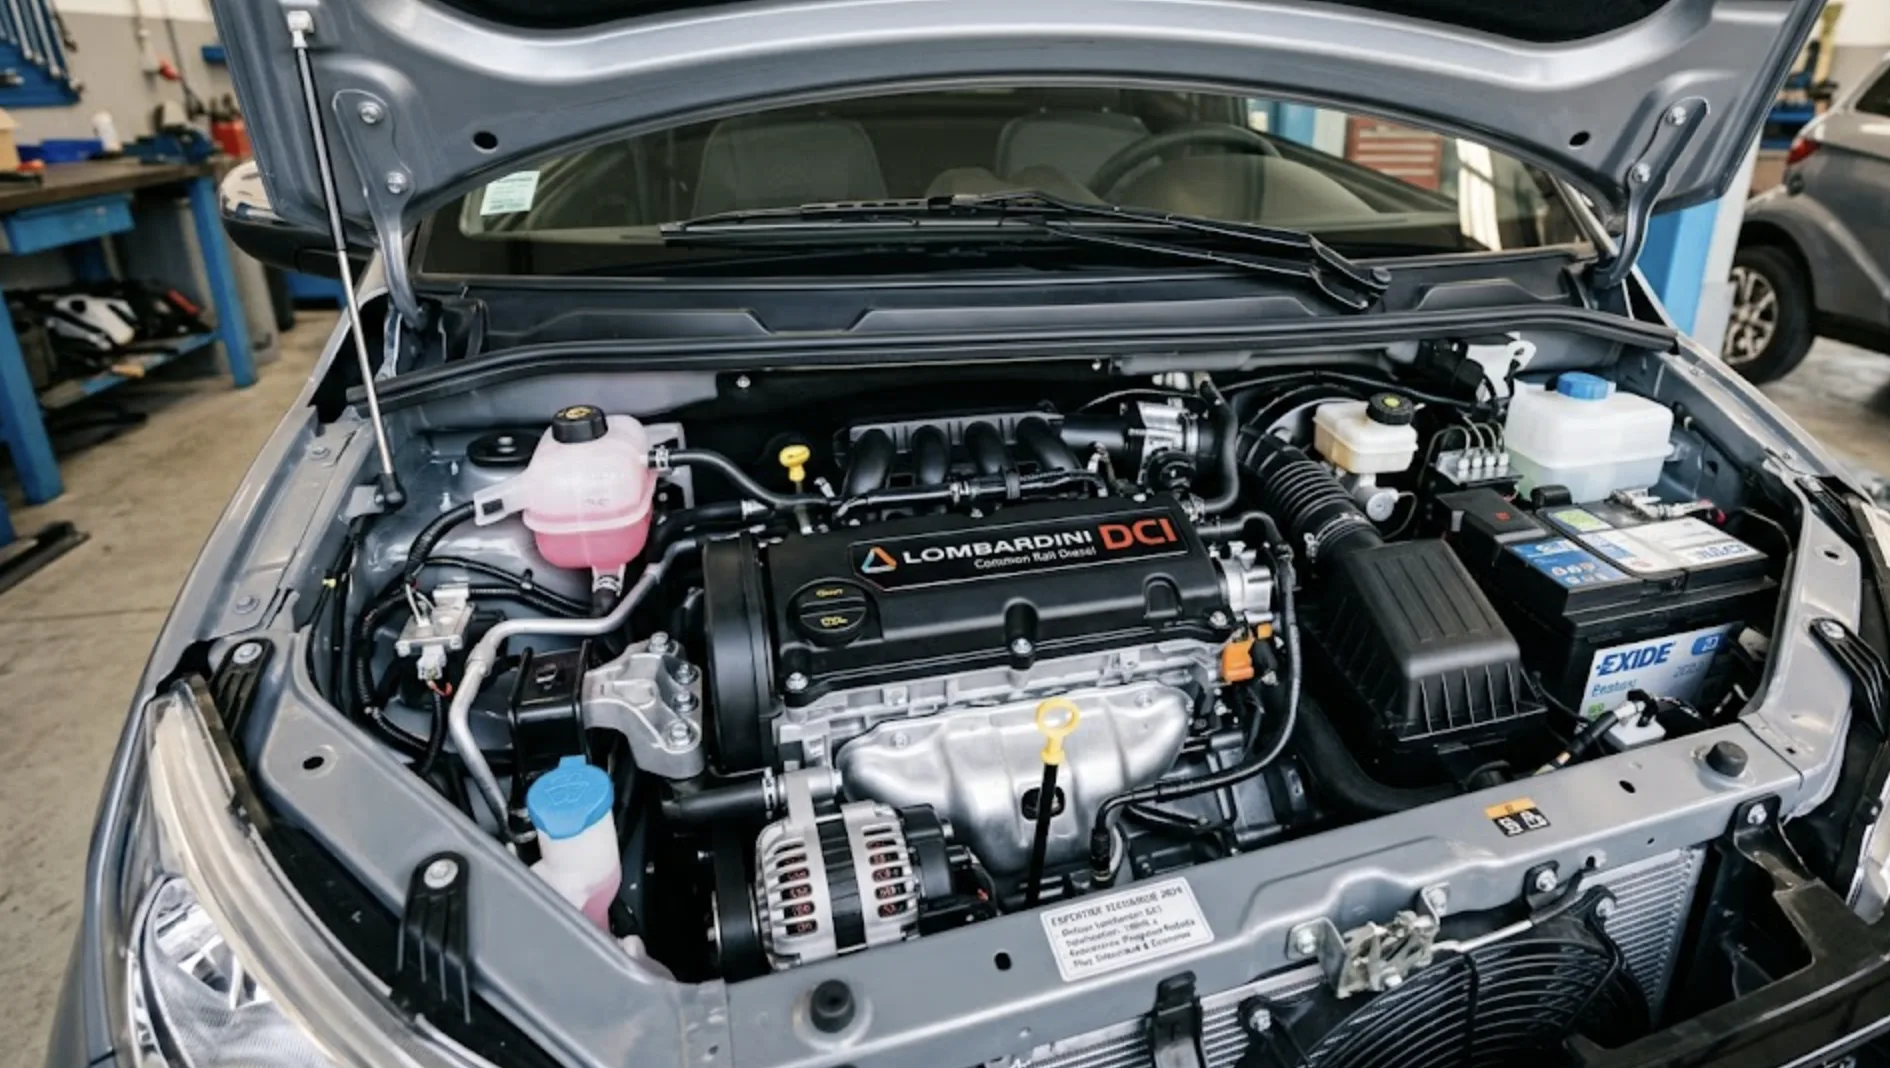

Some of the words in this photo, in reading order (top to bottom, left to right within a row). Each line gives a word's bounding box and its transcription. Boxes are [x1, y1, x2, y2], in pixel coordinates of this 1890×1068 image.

[902, 531, 1093, 564] LOMBARDINI
[1098, 518, 1177, 550] DCI
[973, 555, 1031, 569] Common
[1597, 641, 1674, 676] EXIDE
